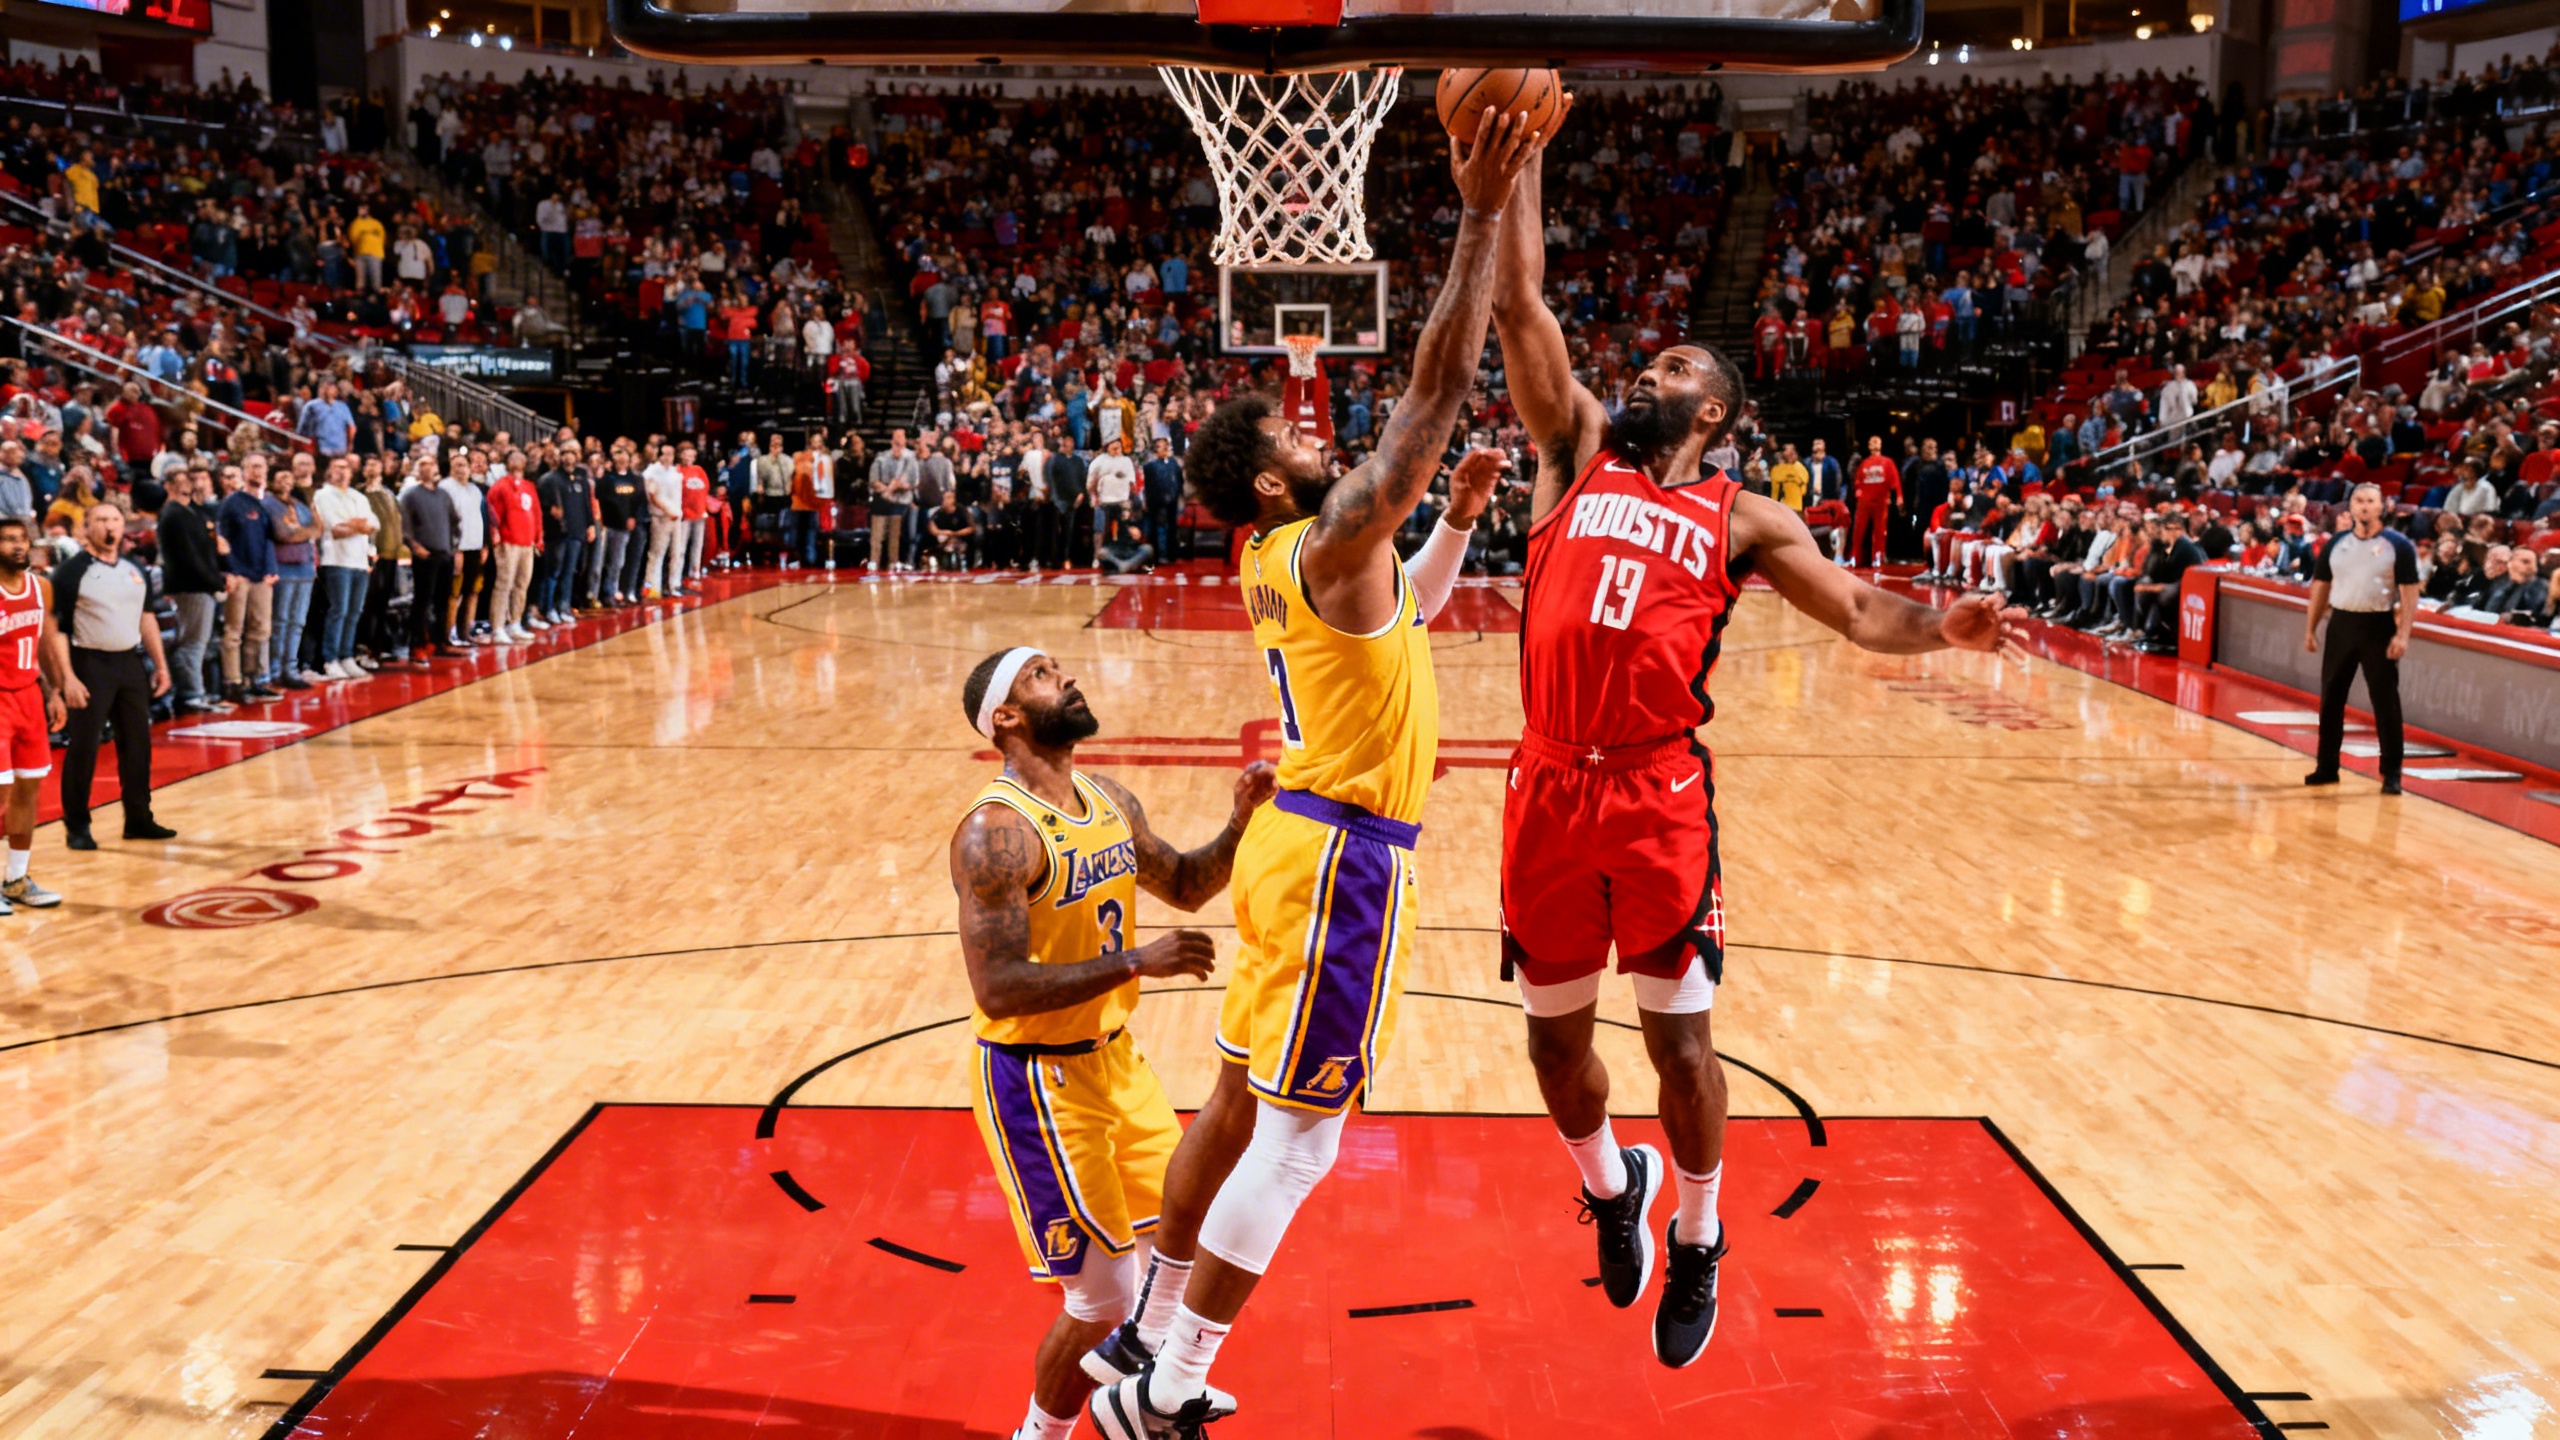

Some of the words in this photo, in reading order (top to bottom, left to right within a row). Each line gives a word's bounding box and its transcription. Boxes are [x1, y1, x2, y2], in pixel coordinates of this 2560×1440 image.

[1590, 555, 1647, 631] 13
[18, 636, 33, 670] 11
[1097, 897, 1124, 956] 3
